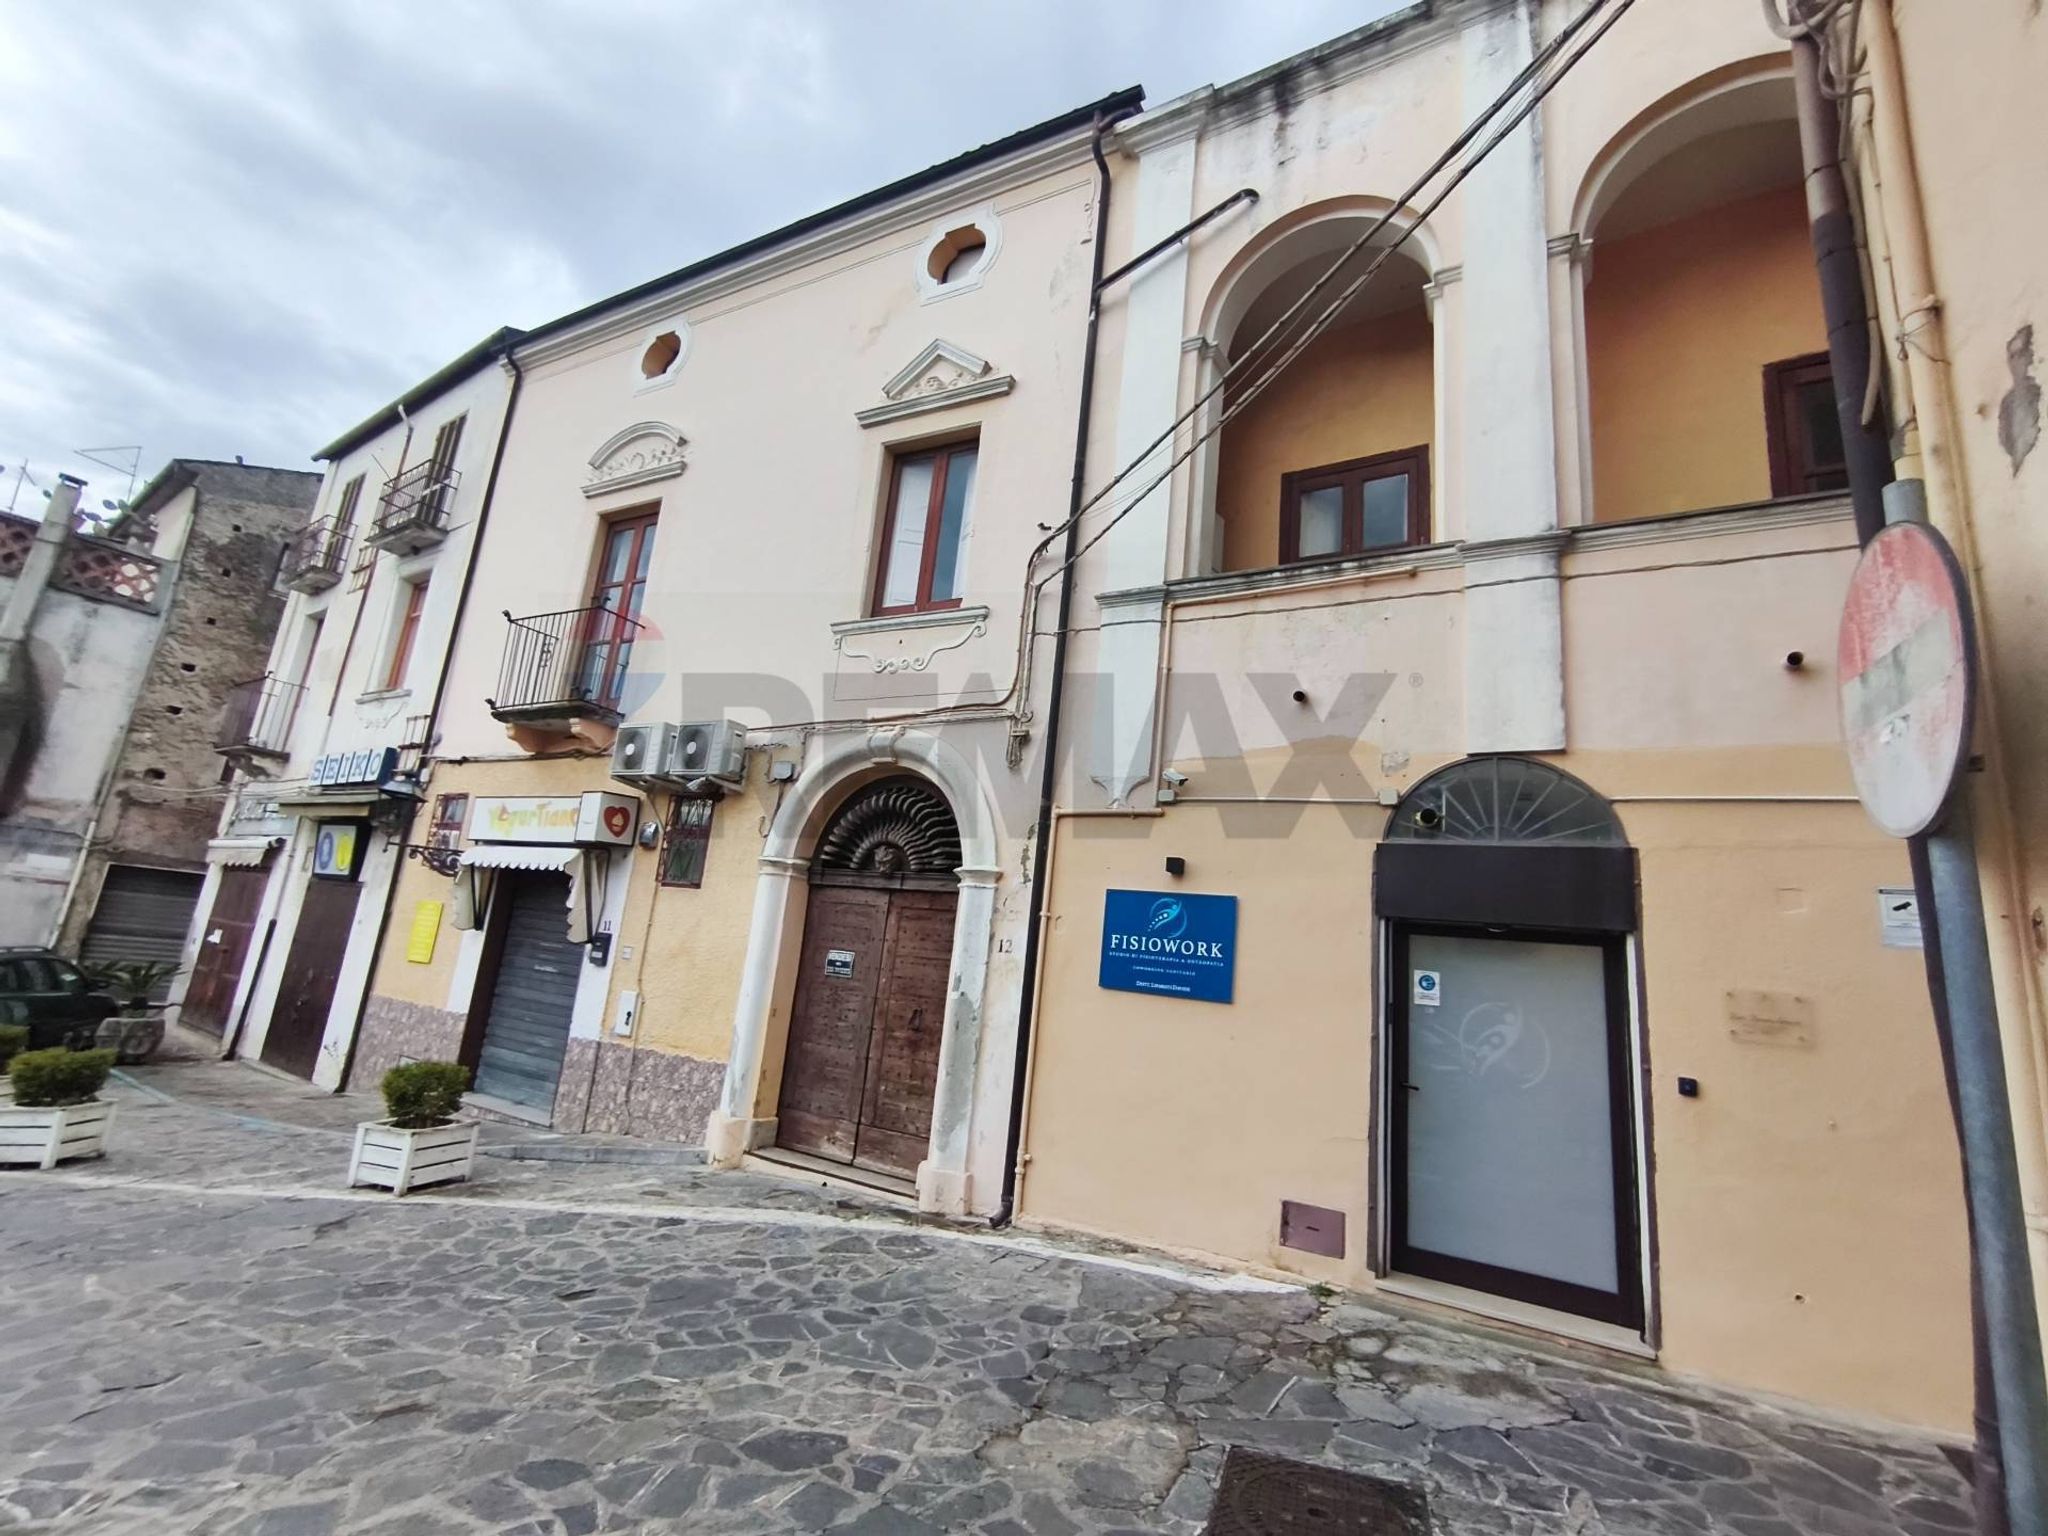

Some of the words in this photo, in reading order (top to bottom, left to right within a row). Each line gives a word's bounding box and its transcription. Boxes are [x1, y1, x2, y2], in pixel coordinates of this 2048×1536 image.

[311, 752, 382, 781] SEIKO
[603, 920, 612, 931] 11
[998, 939, 1013, 953] 12
[1110, 934, 1223, 958] FISIOWORK
